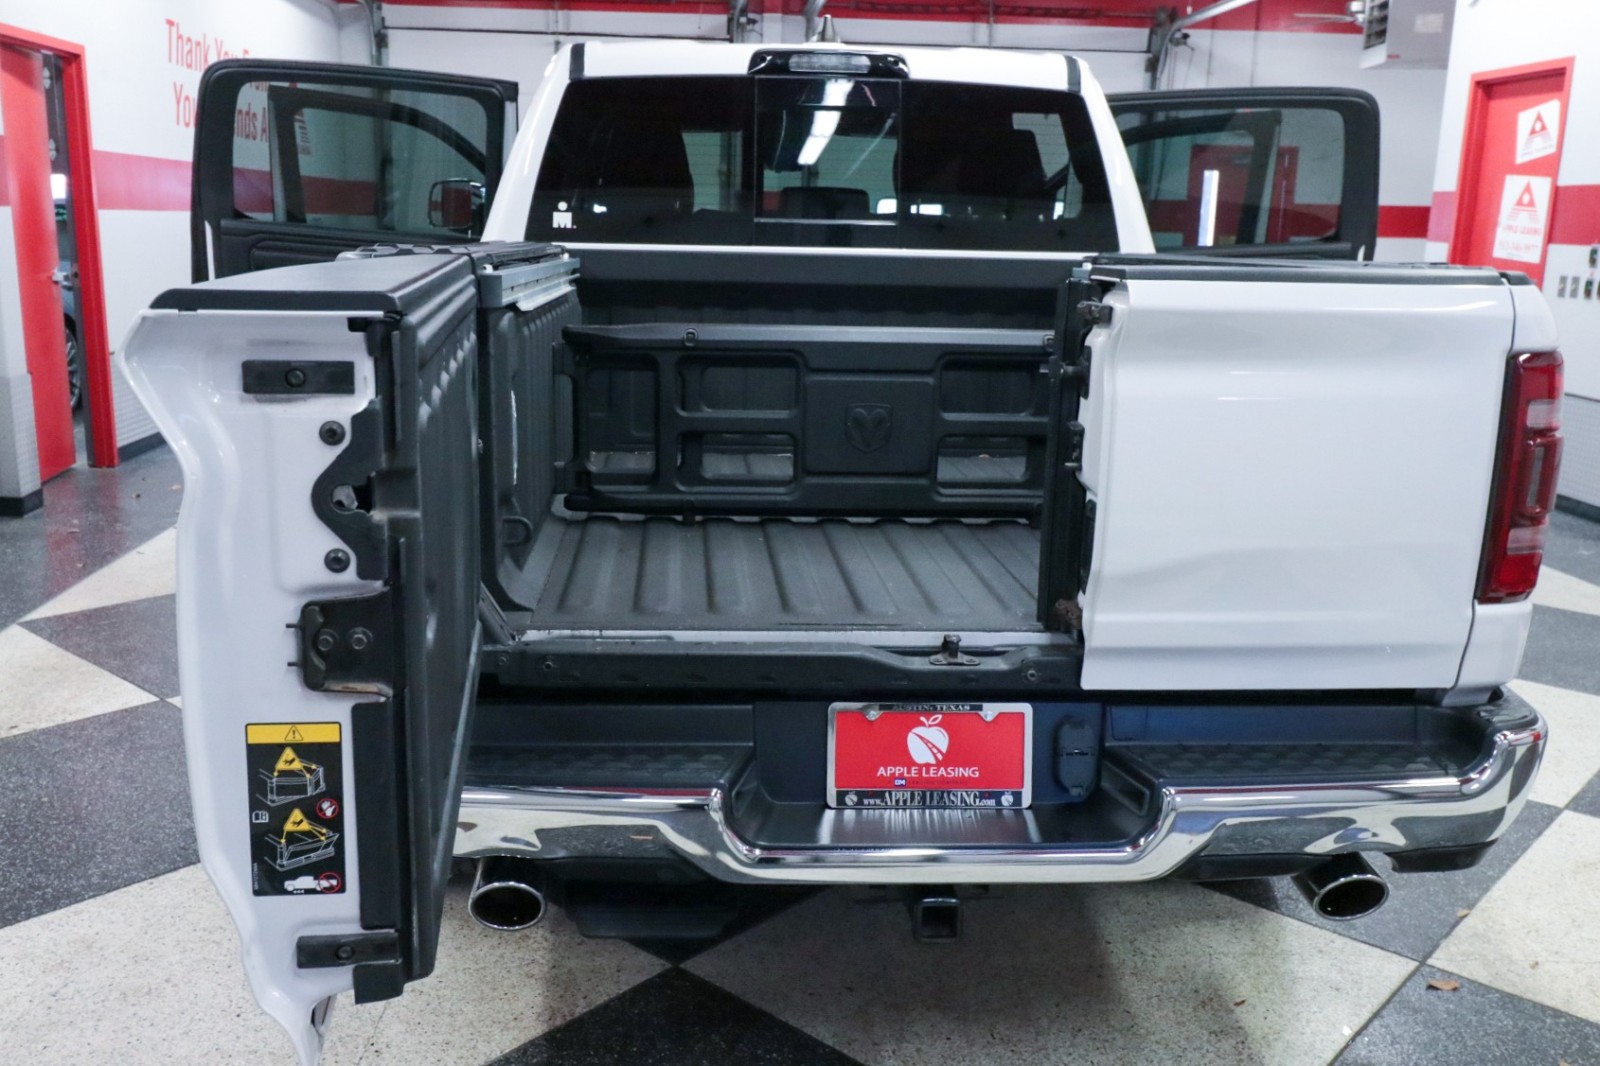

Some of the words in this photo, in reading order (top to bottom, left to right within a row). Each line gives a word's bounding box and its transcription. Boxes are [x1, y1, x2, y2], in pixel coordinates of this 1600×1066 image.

[165, 18, 210, 72] Thank
[877, 766, 919, 778] APPLE
[922, 766, 980, 778] LEASING
